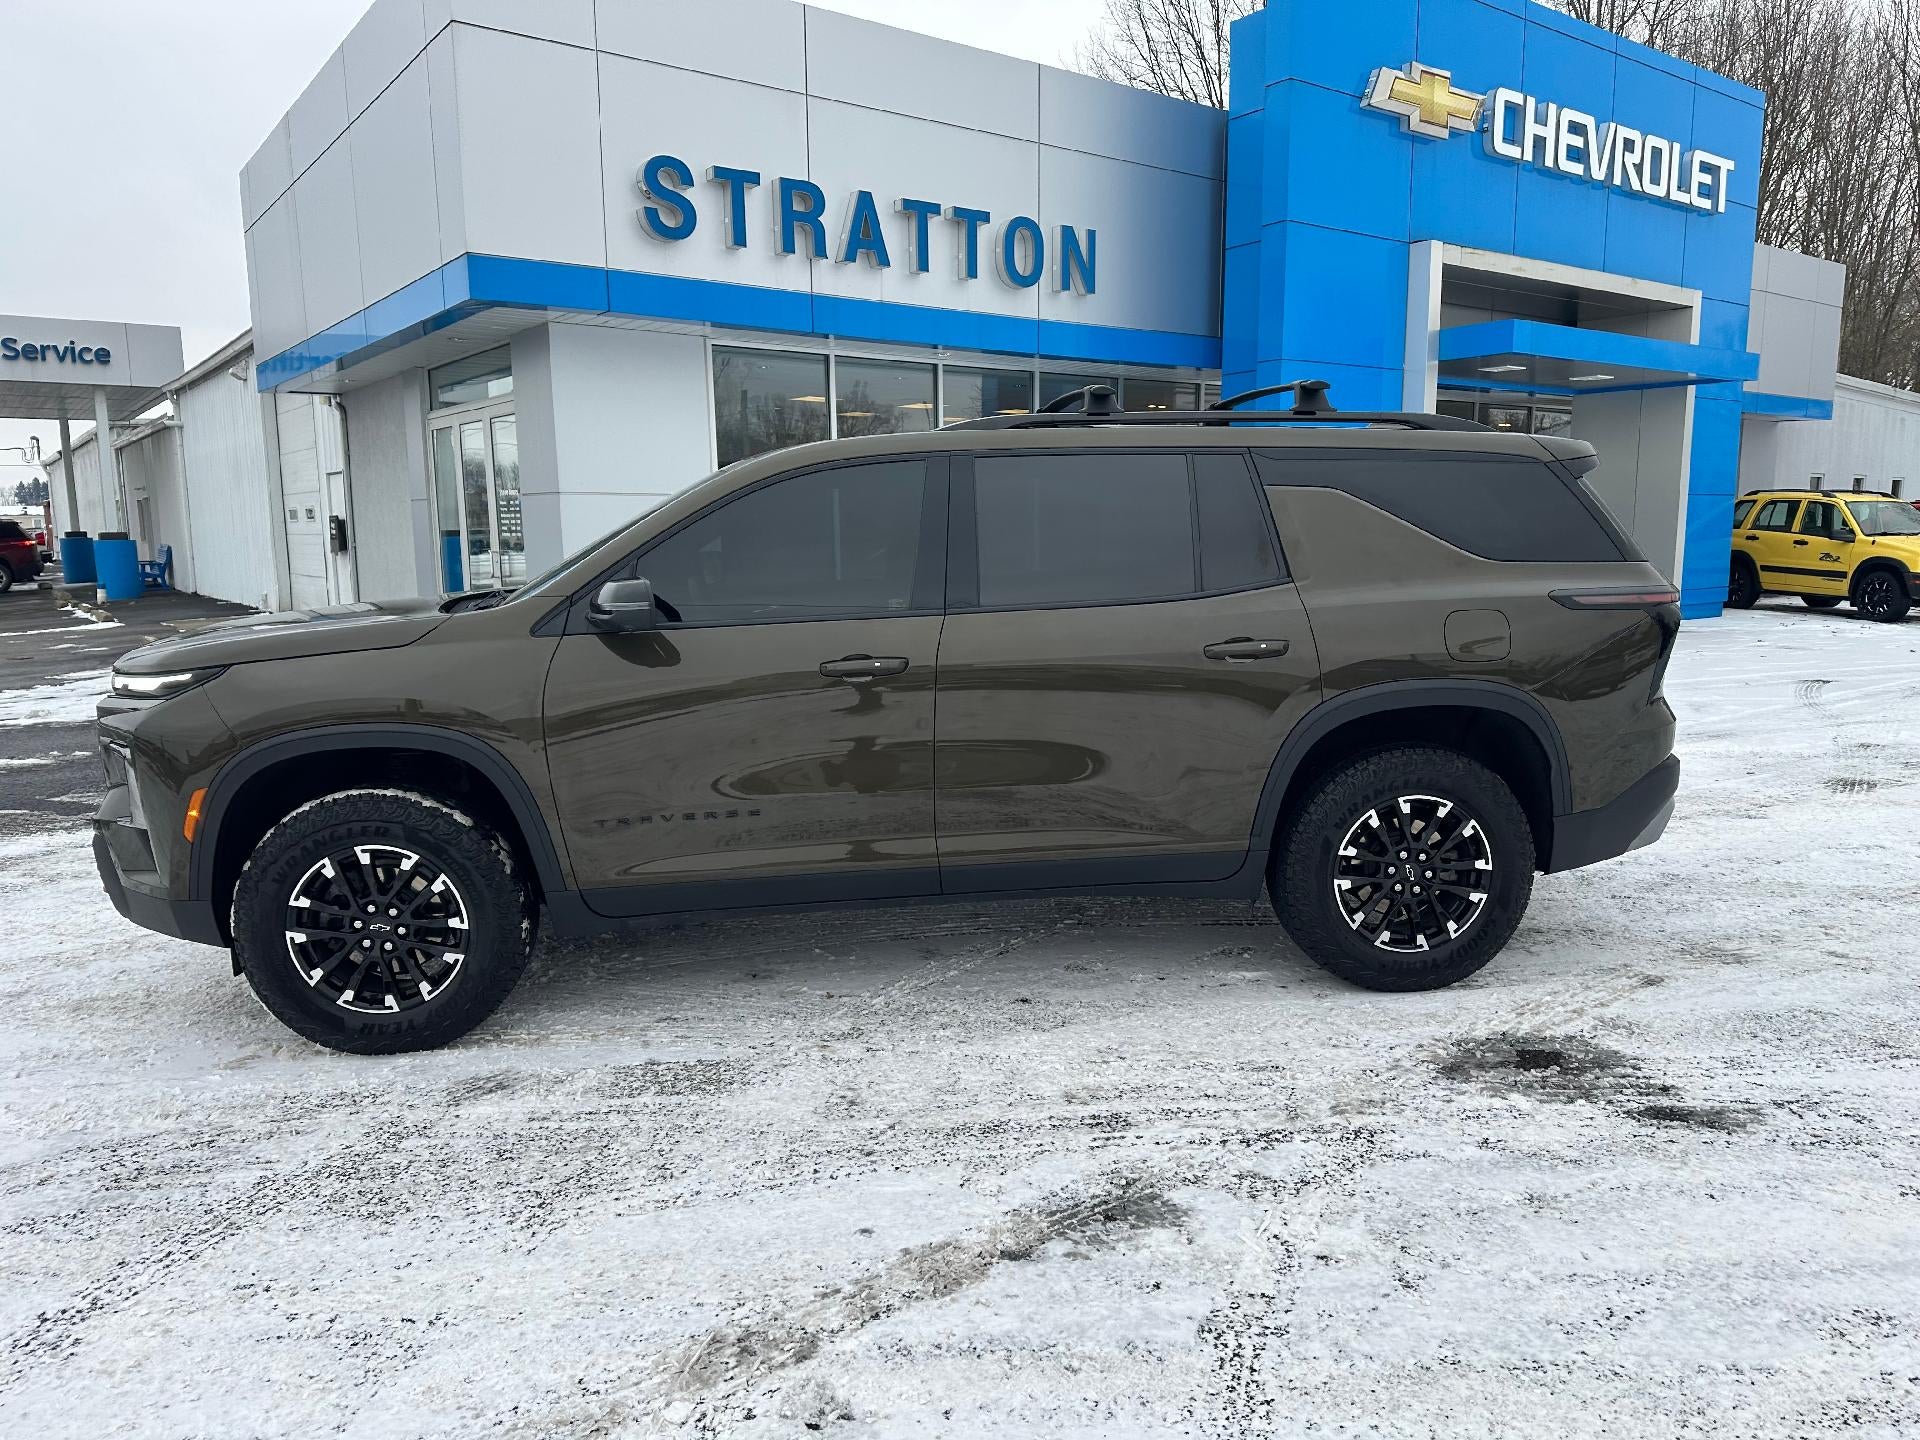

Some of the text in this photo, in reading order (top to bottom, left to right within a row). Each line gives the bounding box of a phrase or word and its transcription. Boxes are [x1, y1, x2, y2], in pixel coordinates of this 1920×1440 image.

[1485, 86, 1735, 214] CHEVROLET
[637, 154, 1097, 296] STRATTON
[0, 337, 112, 365] Service
[593, 808, 761, 828] TRAVERSE
